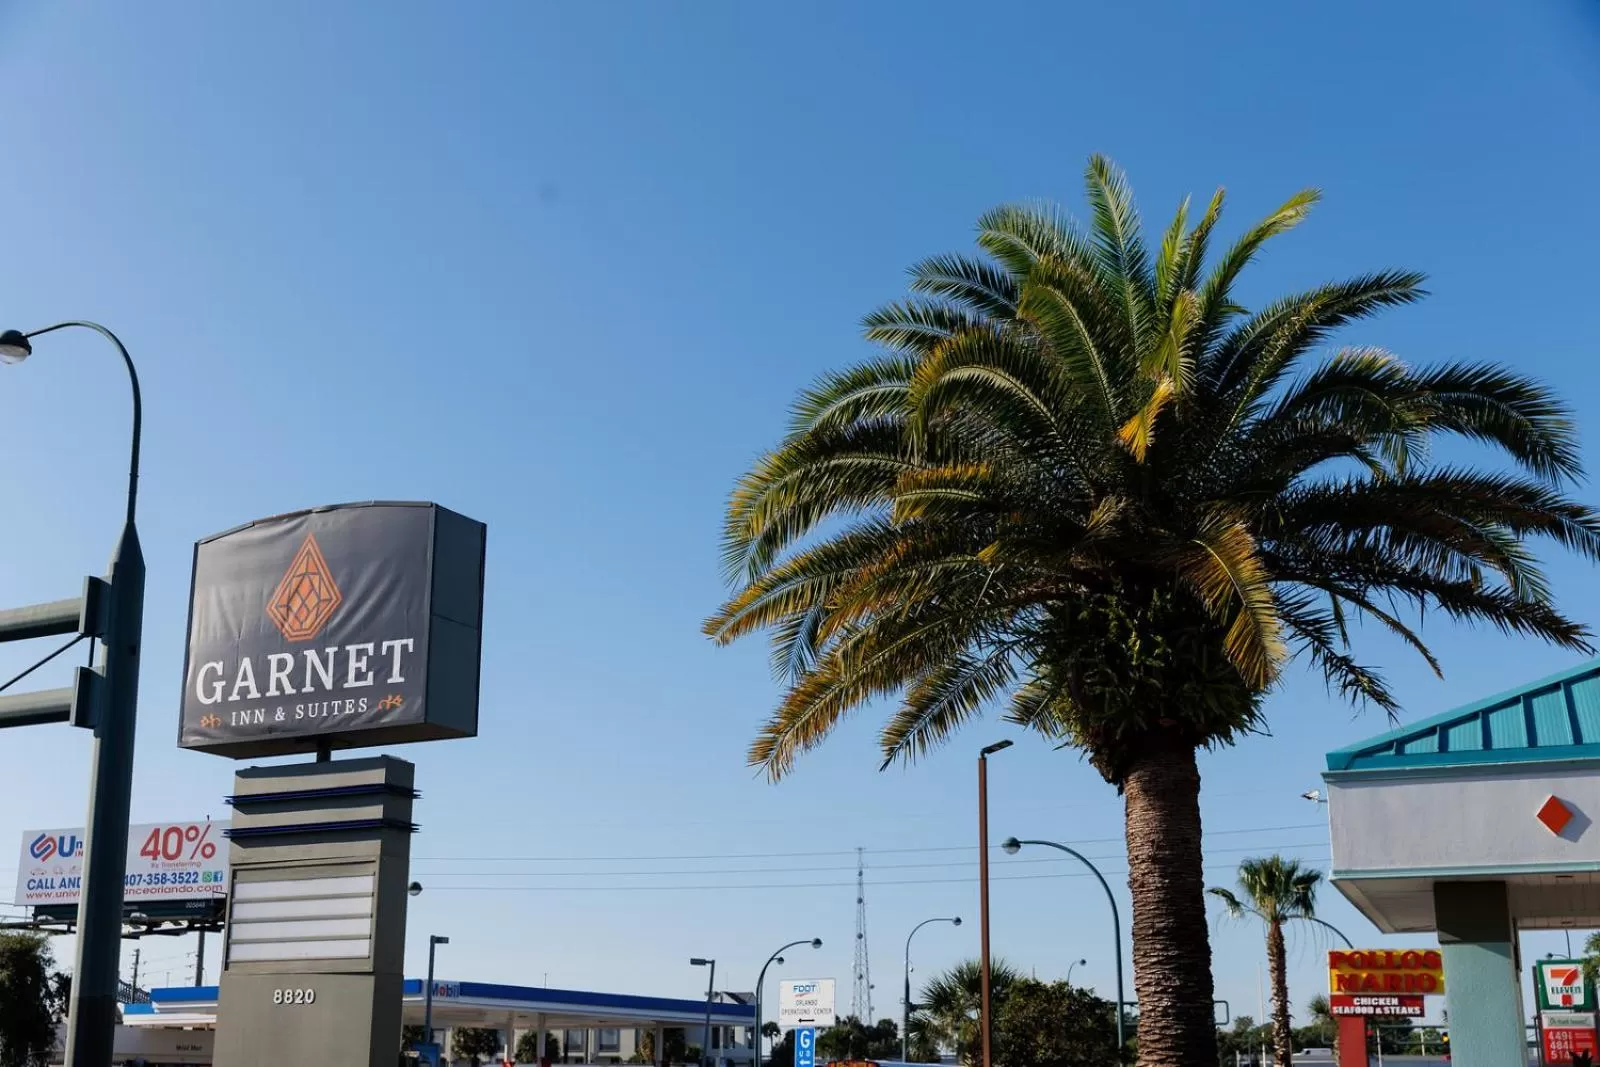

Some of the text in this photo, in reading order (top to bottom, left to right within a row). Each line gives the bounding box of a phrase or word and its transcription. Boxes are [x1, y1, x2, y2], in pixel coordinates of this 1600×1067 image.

[196, 638, 414, 704] GARNET
[231, 698, 368, 726] INN & SUITES
[140, 824, 216, 860] 40%
[27, 878, 56, 890] CALL
[1330, 951, 1442, 969] POLLOS
[432, 983, 460, 998] Mobil
[1336, 973, 1437, 993] MARIO
[1550, 967, 1579, 1007] 7
[273, 989, 316, 1004] 8820
[1353, 997, 1399, 1006] CHICKEN
[813, 1007, 832, 1015] CENTER
[1332, 1006, 1374, 1014] SEAFOOD
[1383, 1006, 1421, 1014] STEAKS
[800, 1031, 811, 1048] G
